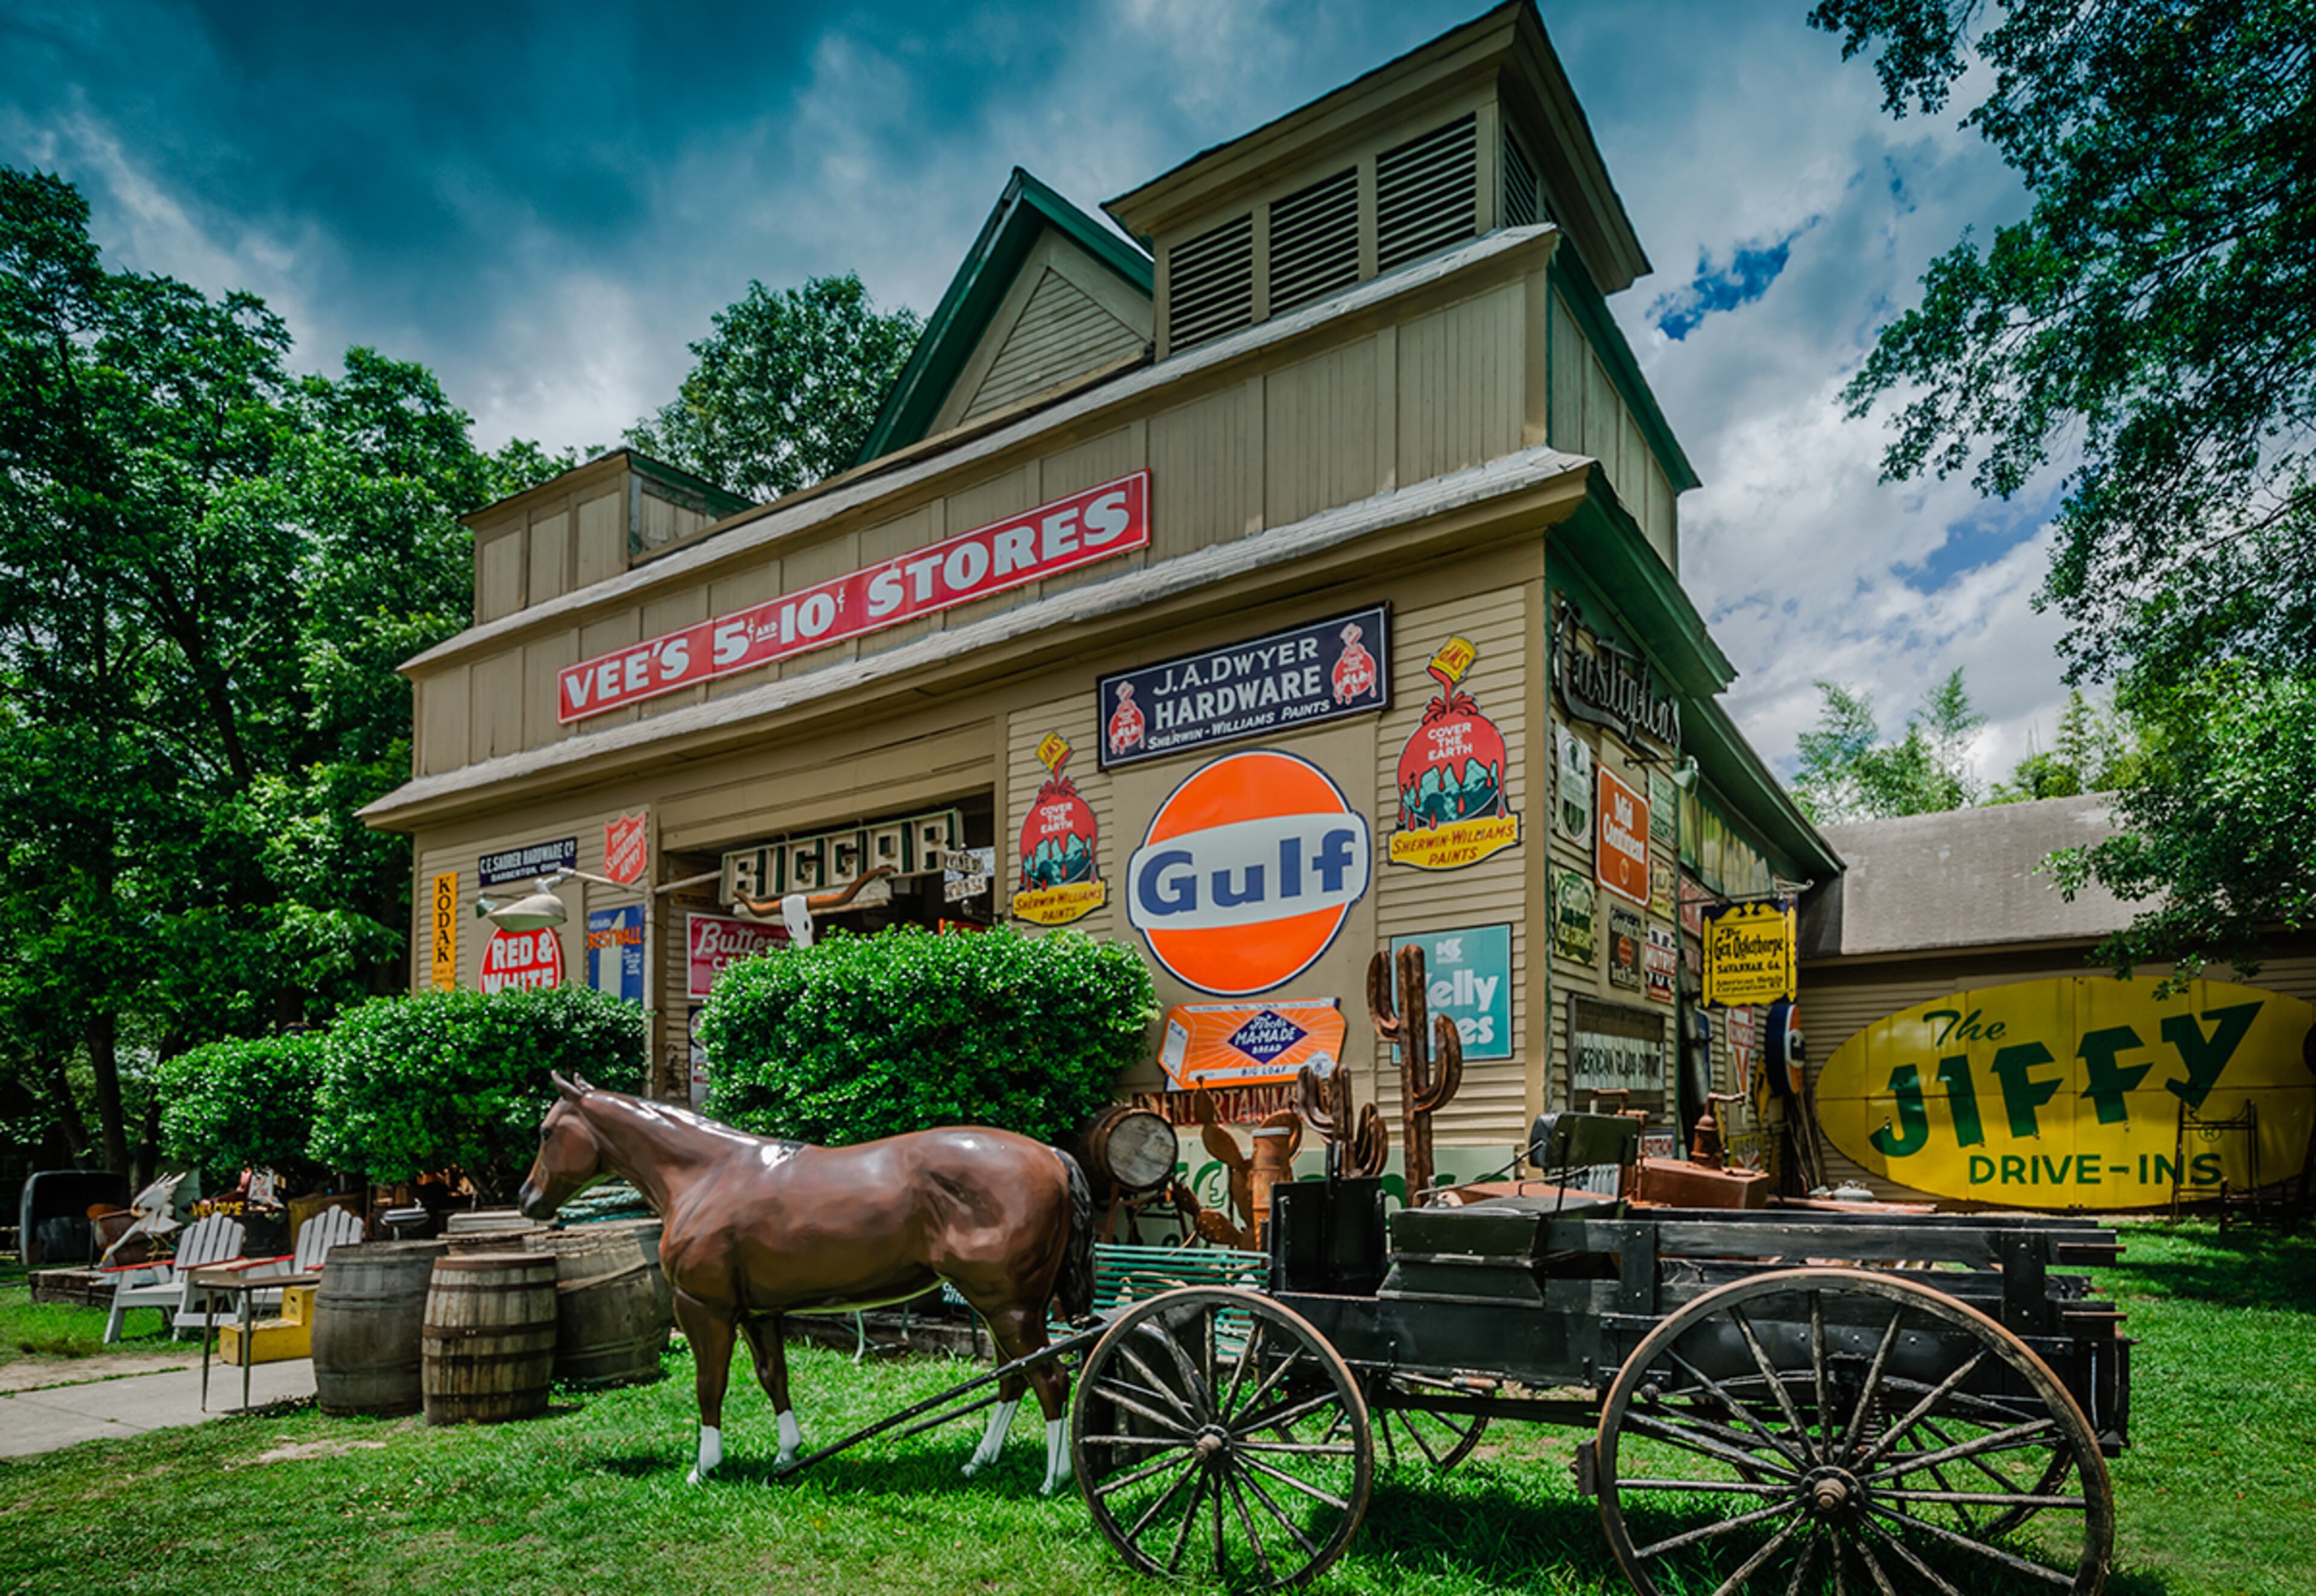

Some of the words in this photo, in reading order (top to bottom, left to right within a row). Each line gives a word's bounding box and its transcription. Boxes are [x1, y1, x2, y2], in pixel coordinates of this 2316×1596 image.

[565, 638, 691, 709] VEE'S
[867, 490, 1130, 618] STORES
[1154, 665, 1322, 731] HARDWARE
[1280, 700, 1330, 721] PAINTS
[1427, 722, 1472, 741] COVER
[1427, 743, 1473, 762] EARTH
[1436, 735, 1463, 750] THE
[1039, 801, 1074, 817] COVER
[1040, 819, 1074, 834] EARTH
[1046, 814, 1066, 826] THE
[1428, 846, 1479, 867] PAINTS
[1137, 828, 1356, 916] Gulf
[436, 877, 451, 963] KODAK
[1041, 905, 1078, 922] PAINTS
[491, 936, 534, 971] RED
[536, 932, 554, 963] &
[1923, 1008, 2007, 1048] The
[1869, 1001, 2265, 1158] JIFFY
